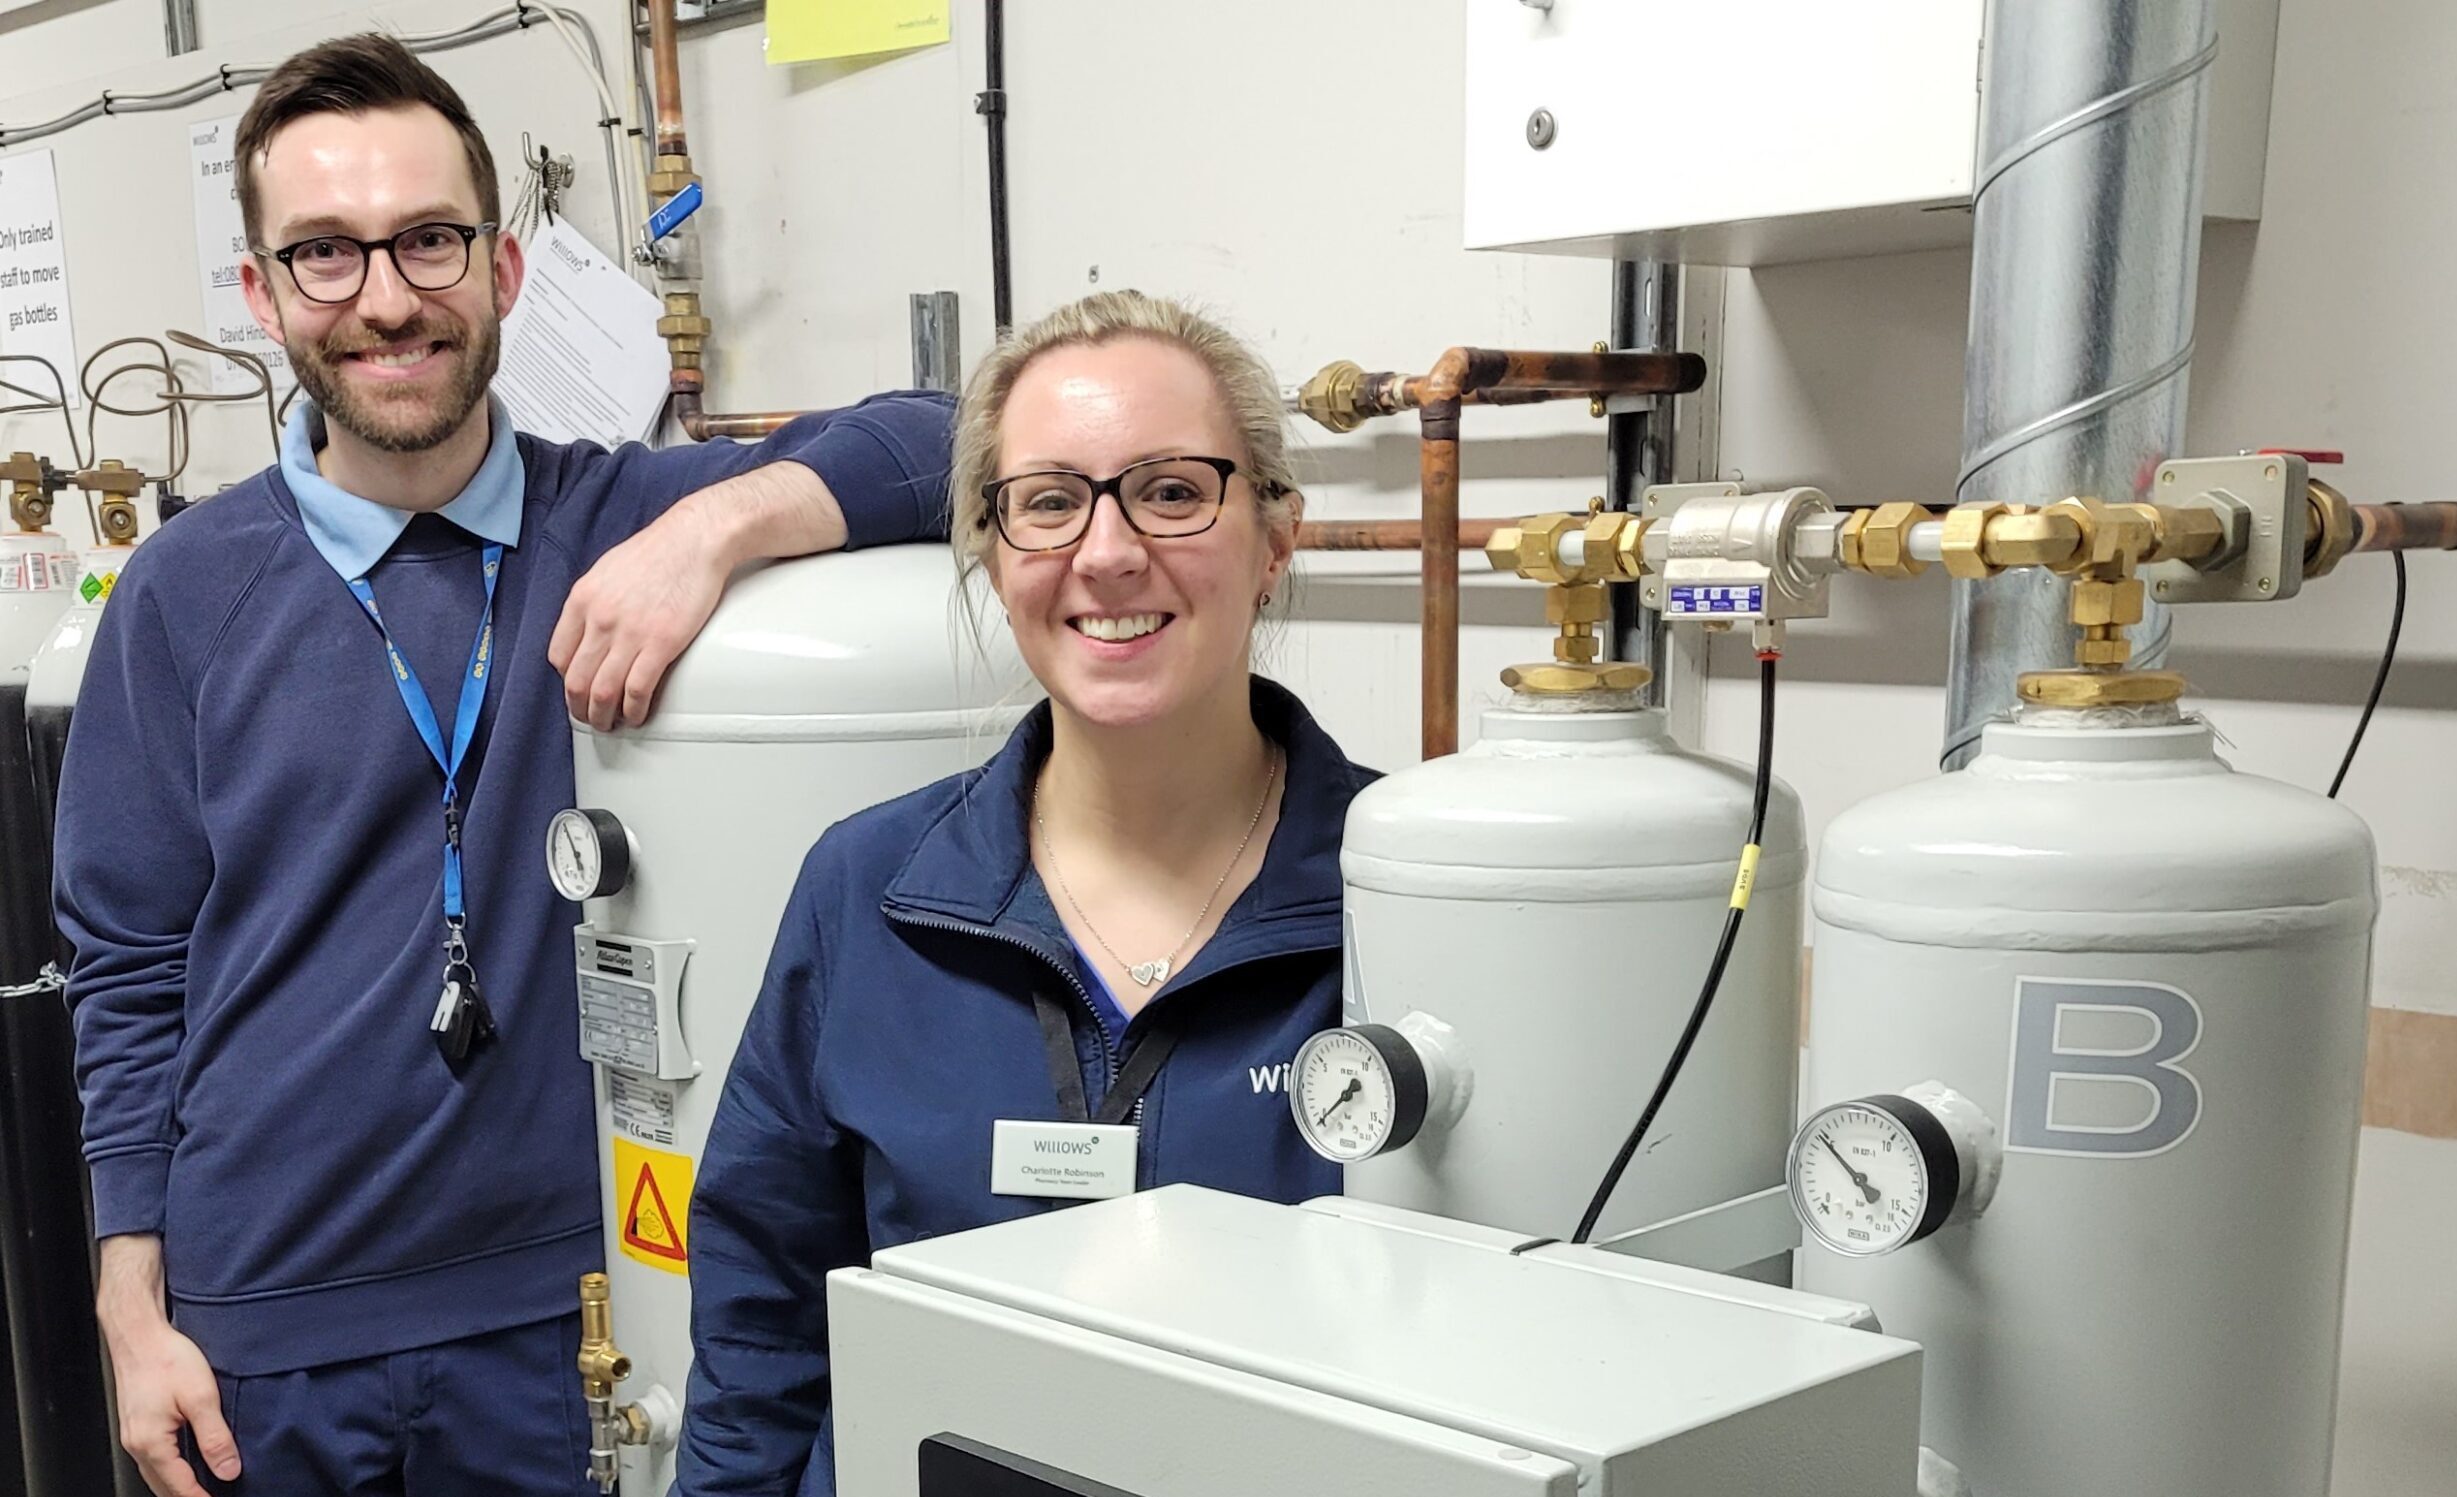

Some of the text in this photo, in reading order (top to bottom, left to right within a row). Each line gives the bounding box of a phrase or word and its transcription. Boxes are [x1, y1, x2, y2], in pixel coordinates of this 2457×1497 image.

[212, 162, 223, 175] an
[19, 220, 54, 246] trained
[0, 265, 60, 288] staff to move
[9, 302, 58, 332] gas bottles
[219, 325, 245, 343] David
[1361, 1061, 1369, 1072] 10
[2003, 975, 2204, 1160] B
[1249, 1062, 1291, 1093] Wi
[1370, 1111, 1378, 1122] 15
[1882, 1140, 1892, 1153] 10
[1021, 1165, 1104, 1178] Charlotte Robinson
[1855, 1198, 1865, 1207] bar
[1891, 1199, 1900, 1211] 15
